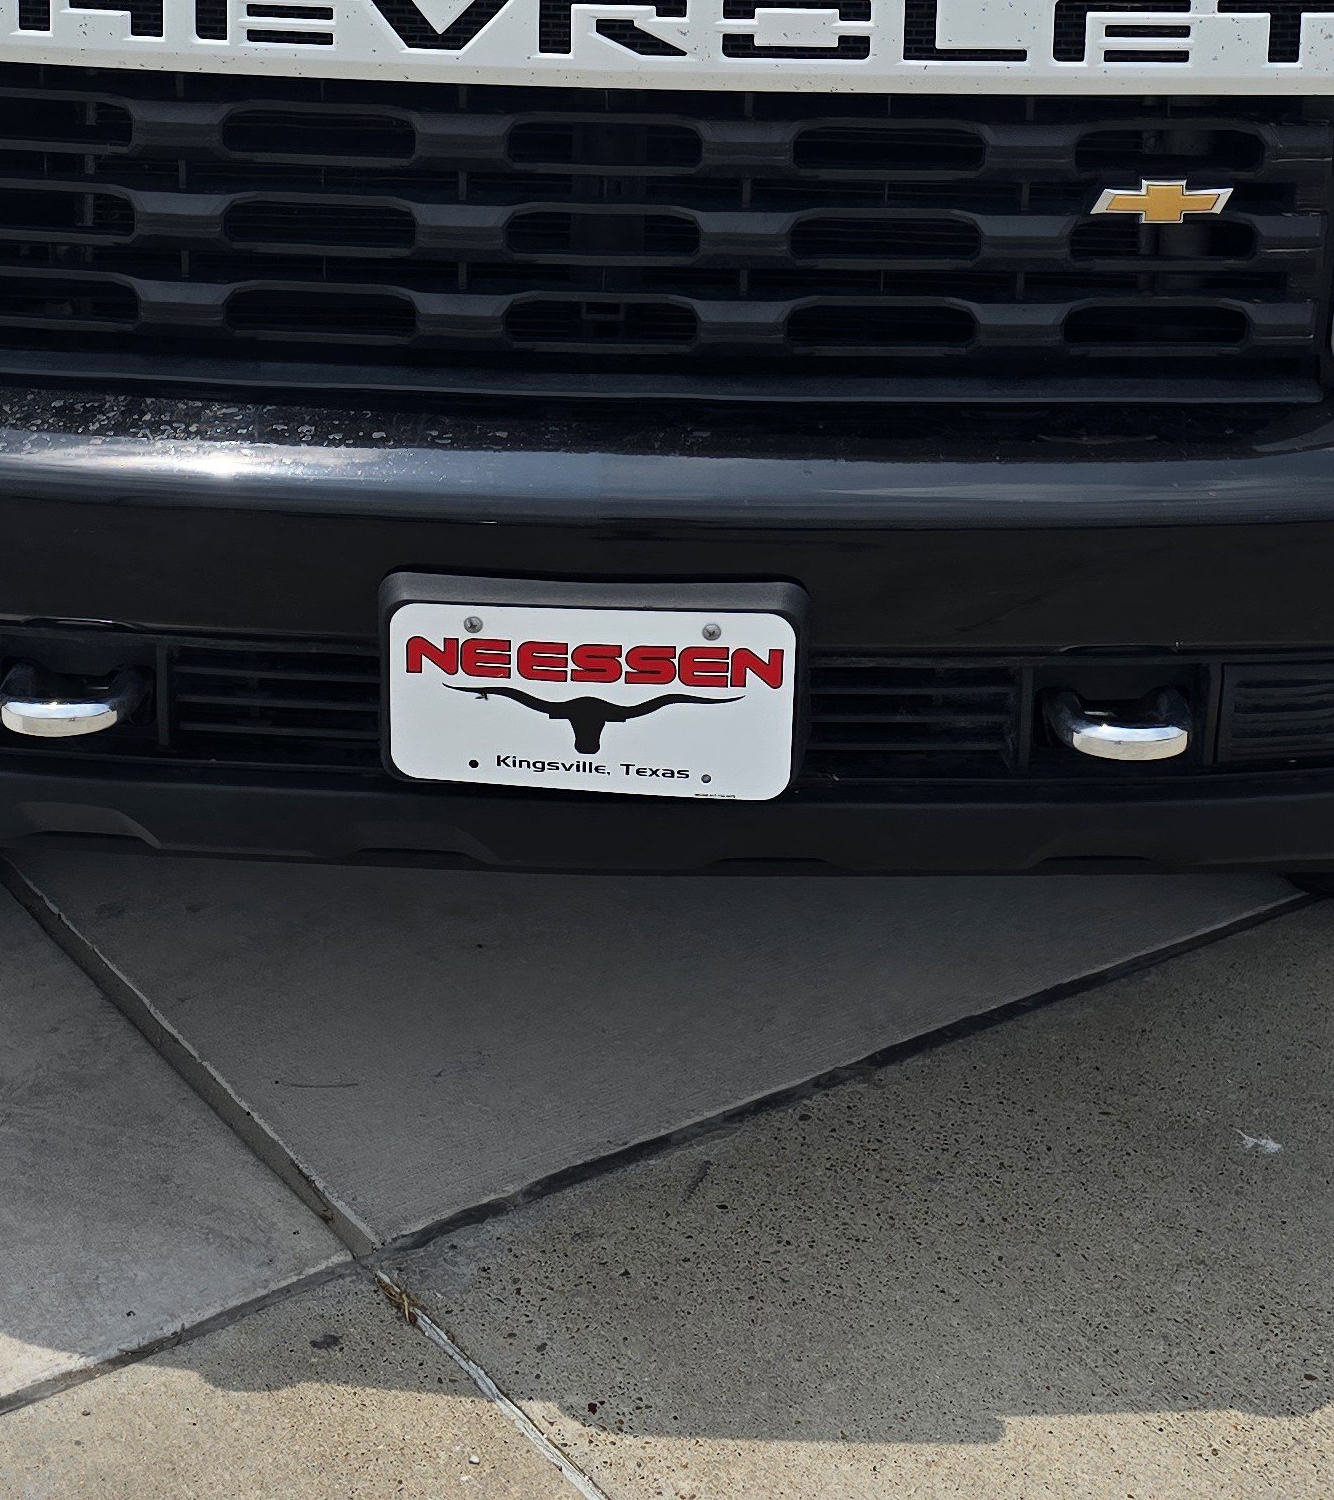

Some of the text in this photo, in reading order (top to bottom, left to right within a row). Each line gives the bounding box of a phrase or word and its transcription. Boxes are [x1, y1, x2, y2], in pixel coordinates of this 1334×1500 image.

[405, 635, 785, 690] NEESSEN
[495, 754, 690, 780] Kingsville, Texas
